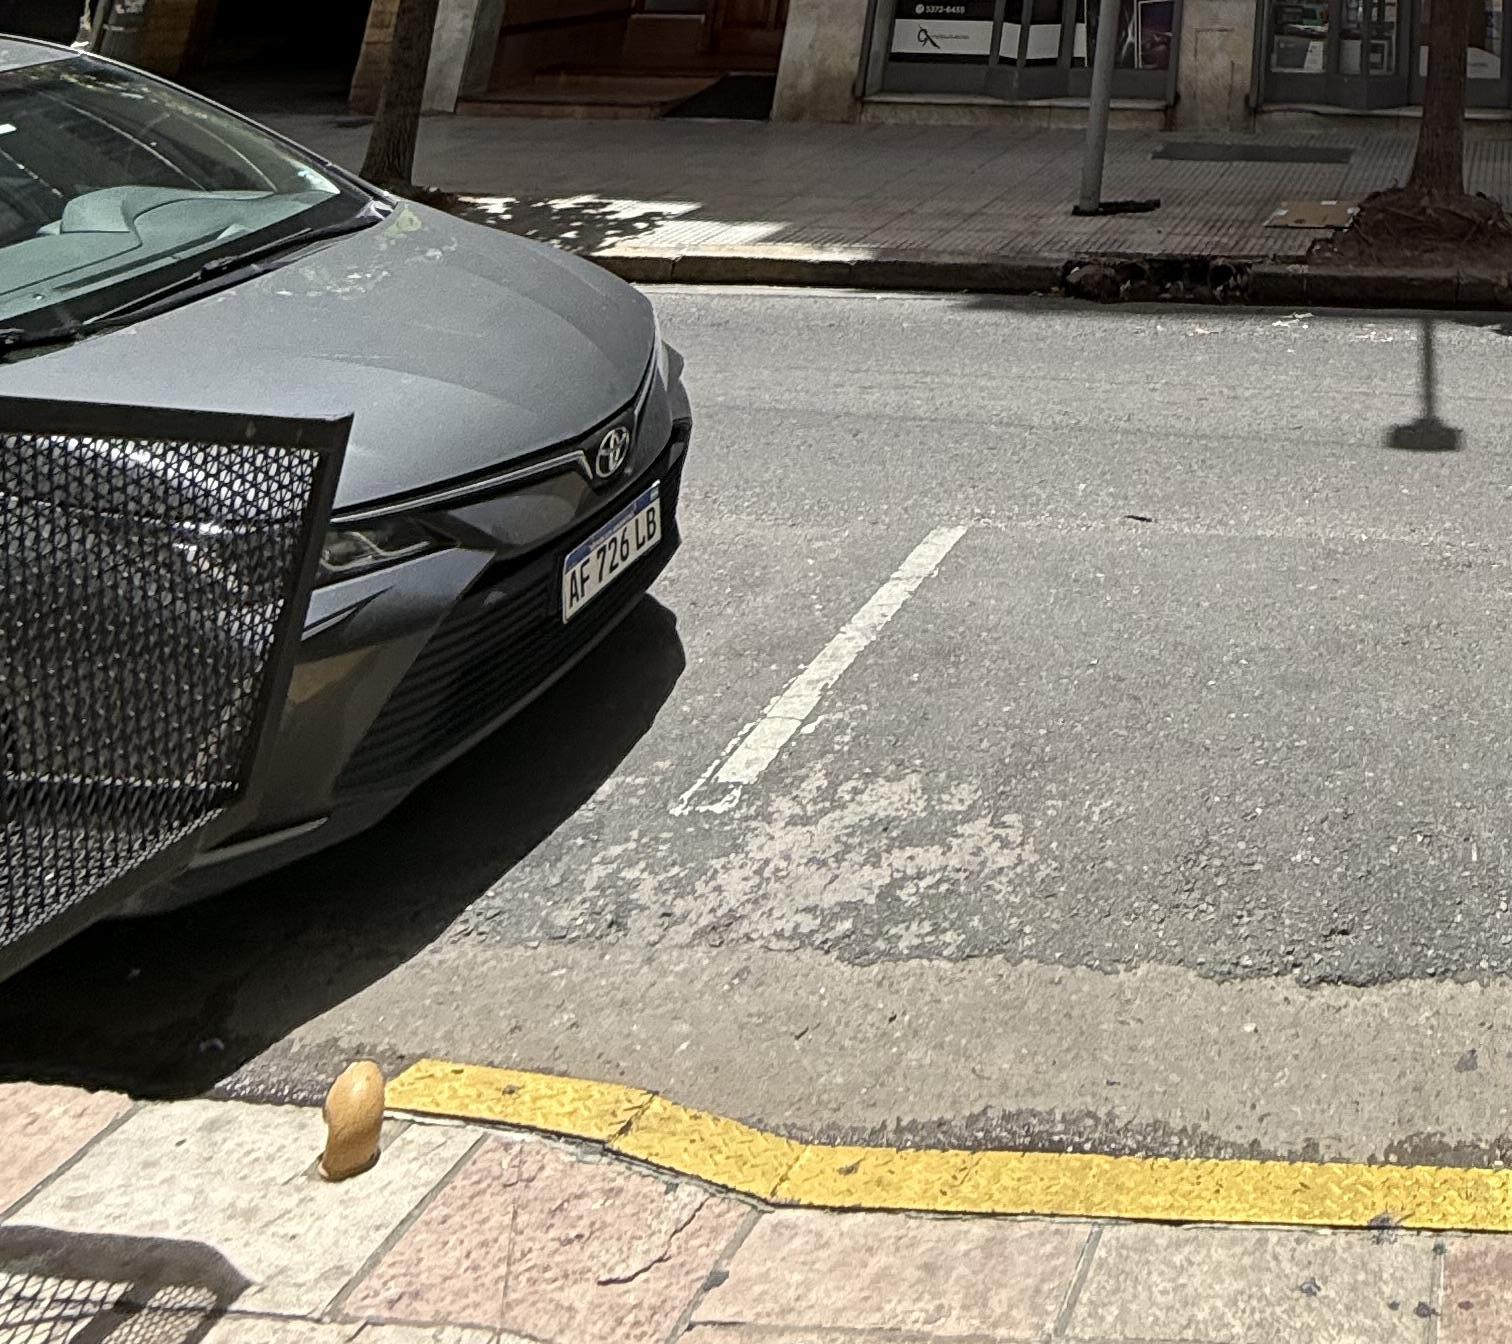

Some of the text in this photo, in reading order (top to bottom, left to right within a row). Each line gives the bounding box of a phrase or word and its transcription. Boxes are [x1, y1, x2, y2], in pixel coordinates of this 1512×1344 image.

[568, 558, 591, 610] AF
[596, 525, 630, 584] 726
[635, 506, 657, 552] LB
